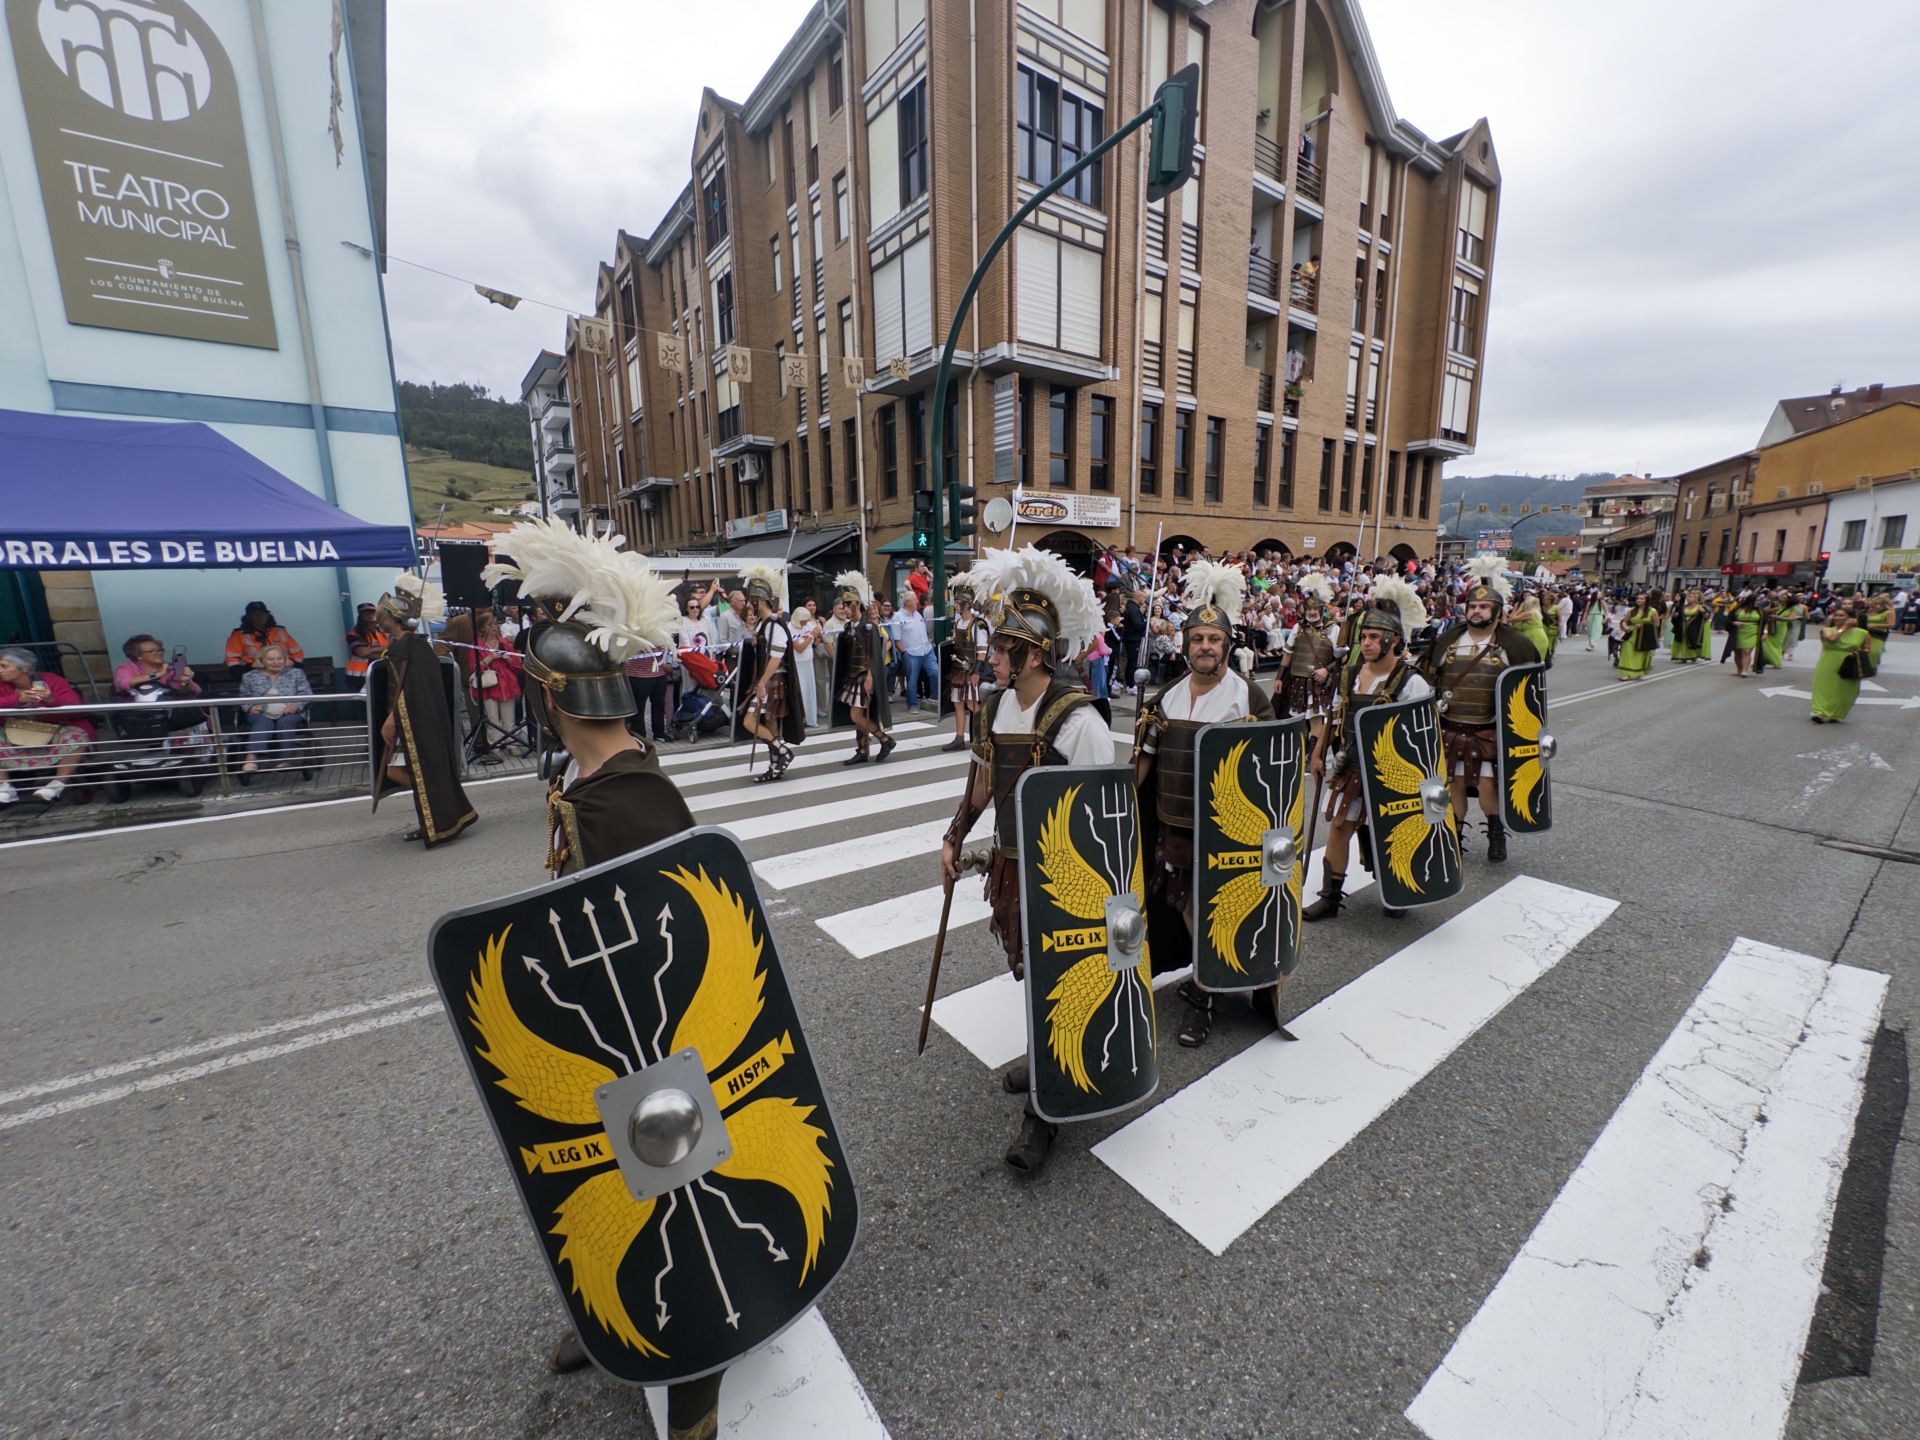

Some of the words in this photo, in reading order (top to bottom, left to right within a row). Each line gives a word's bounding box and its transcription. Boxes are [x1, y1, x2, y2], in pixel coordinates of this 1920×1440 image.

[63, 160, 230, 220] TEATRO
[77, 200, 237, 249] MUNICIPAL
[90, 278, 114, 288] LOS
[118, 281, 180, 298] CORRALES
[184, 291, 199, 301] DE
[203, 295, 245, 308] BUELNA
[114, 274, 203, 293] AYUNTAMIENTO
[207, 287, 221, 297] DE
[1017, 502, 1068, 518] Varela
[0, 540, 152, 565] RRALES
[160, 541, 206, 563] DE
[214, 540, 340, 563] BUELNA
[1390, 802, 1409, 812] LEG
[1411, 800, 1421, 809] IX
[1221, 856, 1245, 866] LEG
[1249, 855, 1260, 865] IX
[1056, 933, 1085, 947] LEG
[1088, 931, 1102, 944] IX
[727, 1056, 771, 1096] HISPA
[548, 1145, 582, 1165] LEG
[584, 1141, 604, 1159] IX
